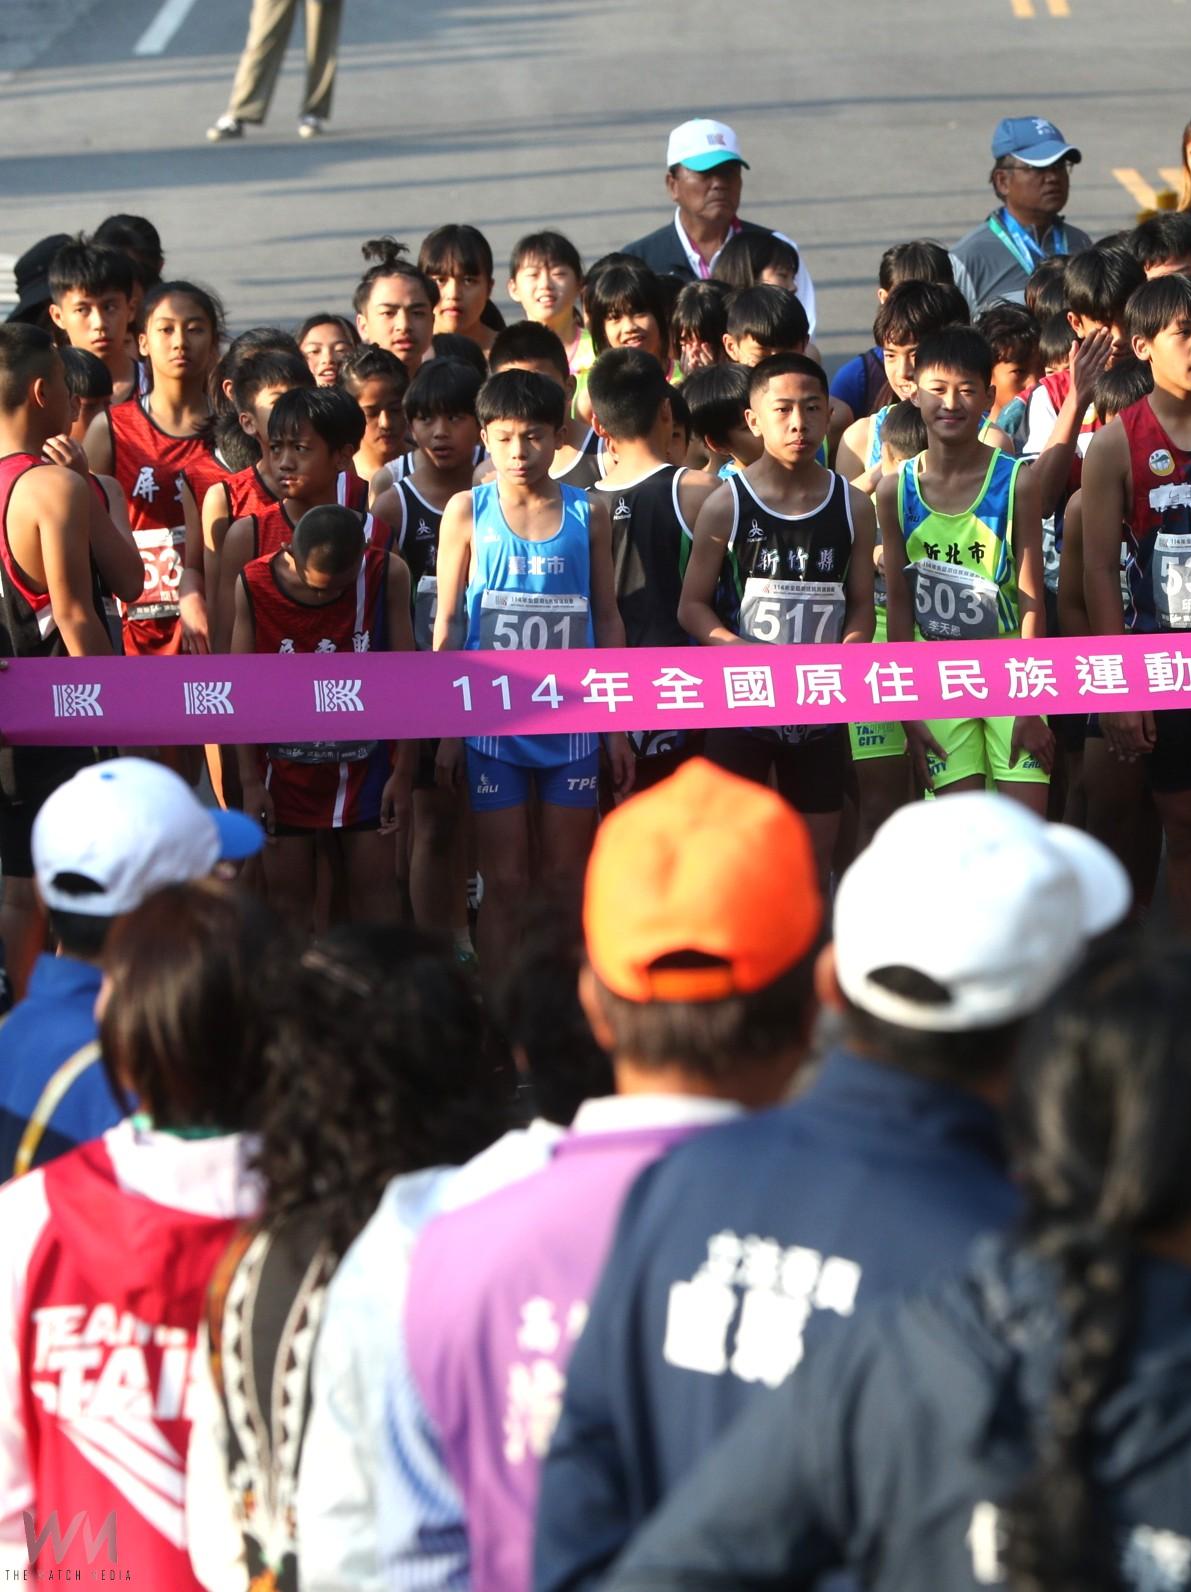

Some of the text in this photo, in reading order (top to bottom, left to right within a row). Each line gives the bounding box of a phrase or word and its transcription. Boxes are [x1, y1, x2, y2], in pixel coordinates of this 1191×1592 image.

[757, 547, 834, 576] 新竹縣
[923, 541, 986, 565] 新北市
[914, 575, 984, 625] 503
[492, 614, 571, 650] 501
[752, 600, 834, 643] 517
[858, 735, 886, 747] CITY
[567, 776, 597, 791] TPE
